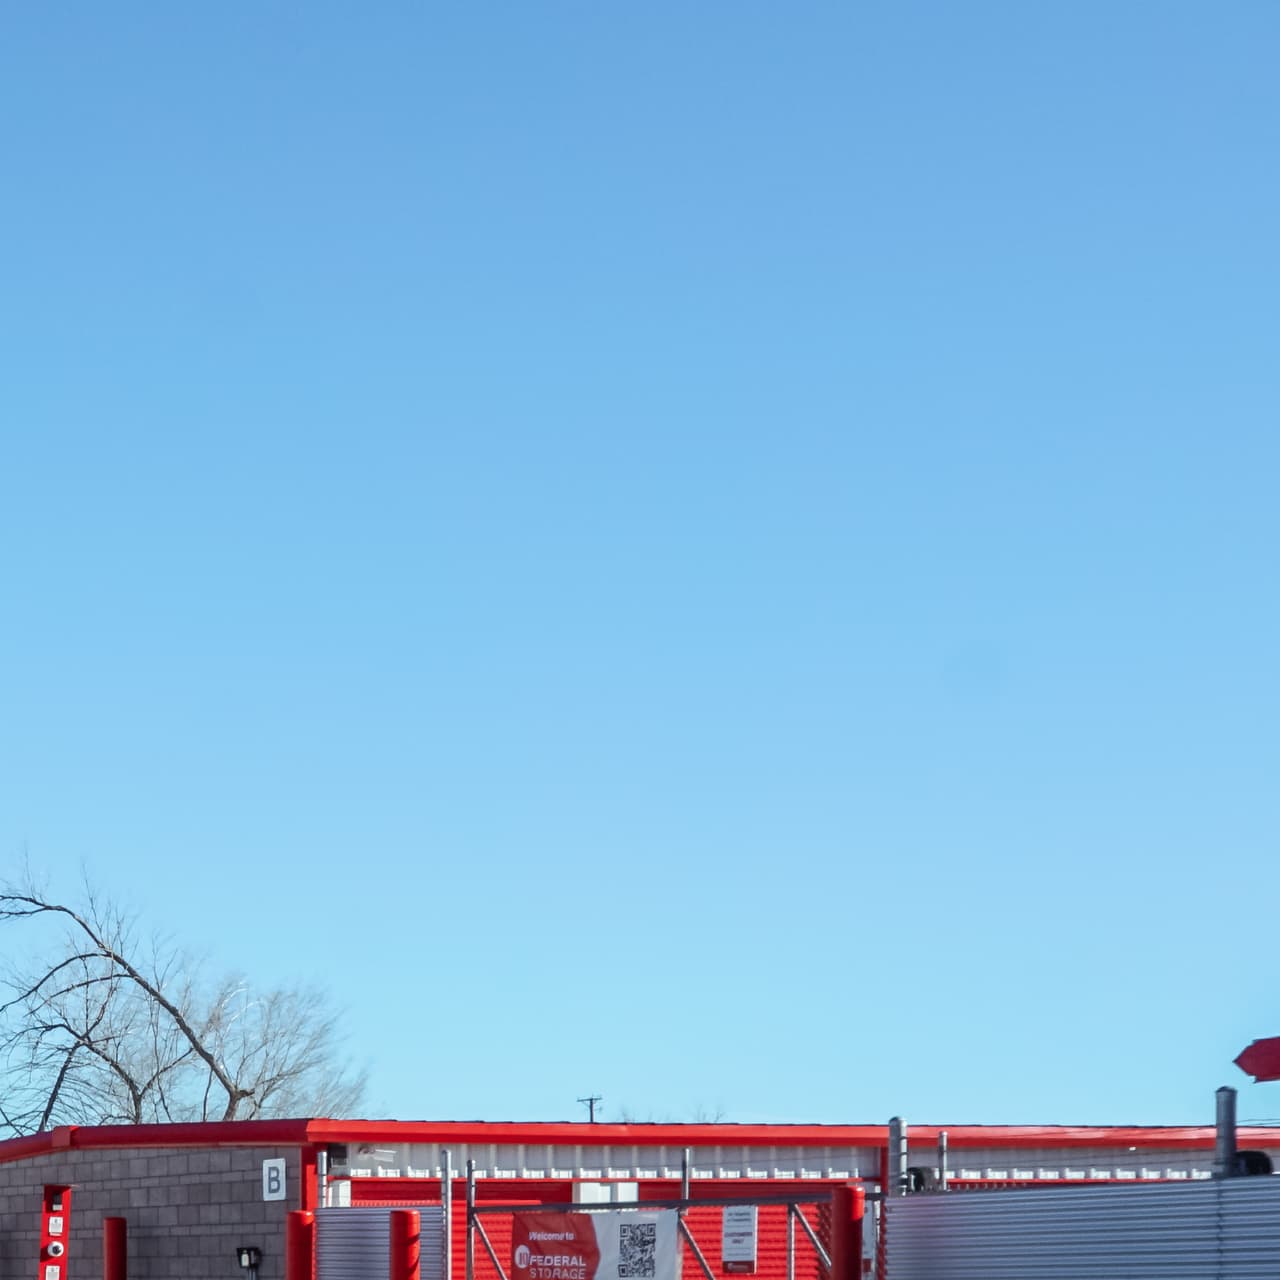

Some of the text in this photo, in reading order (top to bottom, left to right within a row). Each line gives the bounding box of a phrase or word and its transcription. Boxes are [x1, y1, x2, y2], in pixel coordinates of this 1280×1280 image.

[268, 1166, 281, 1194] B
[529, 1231, 575, 1241] Welcome to
[530, 1255, 587, 1267] FEDERAL
[530, 1267, 585, 1280] STORAGE
